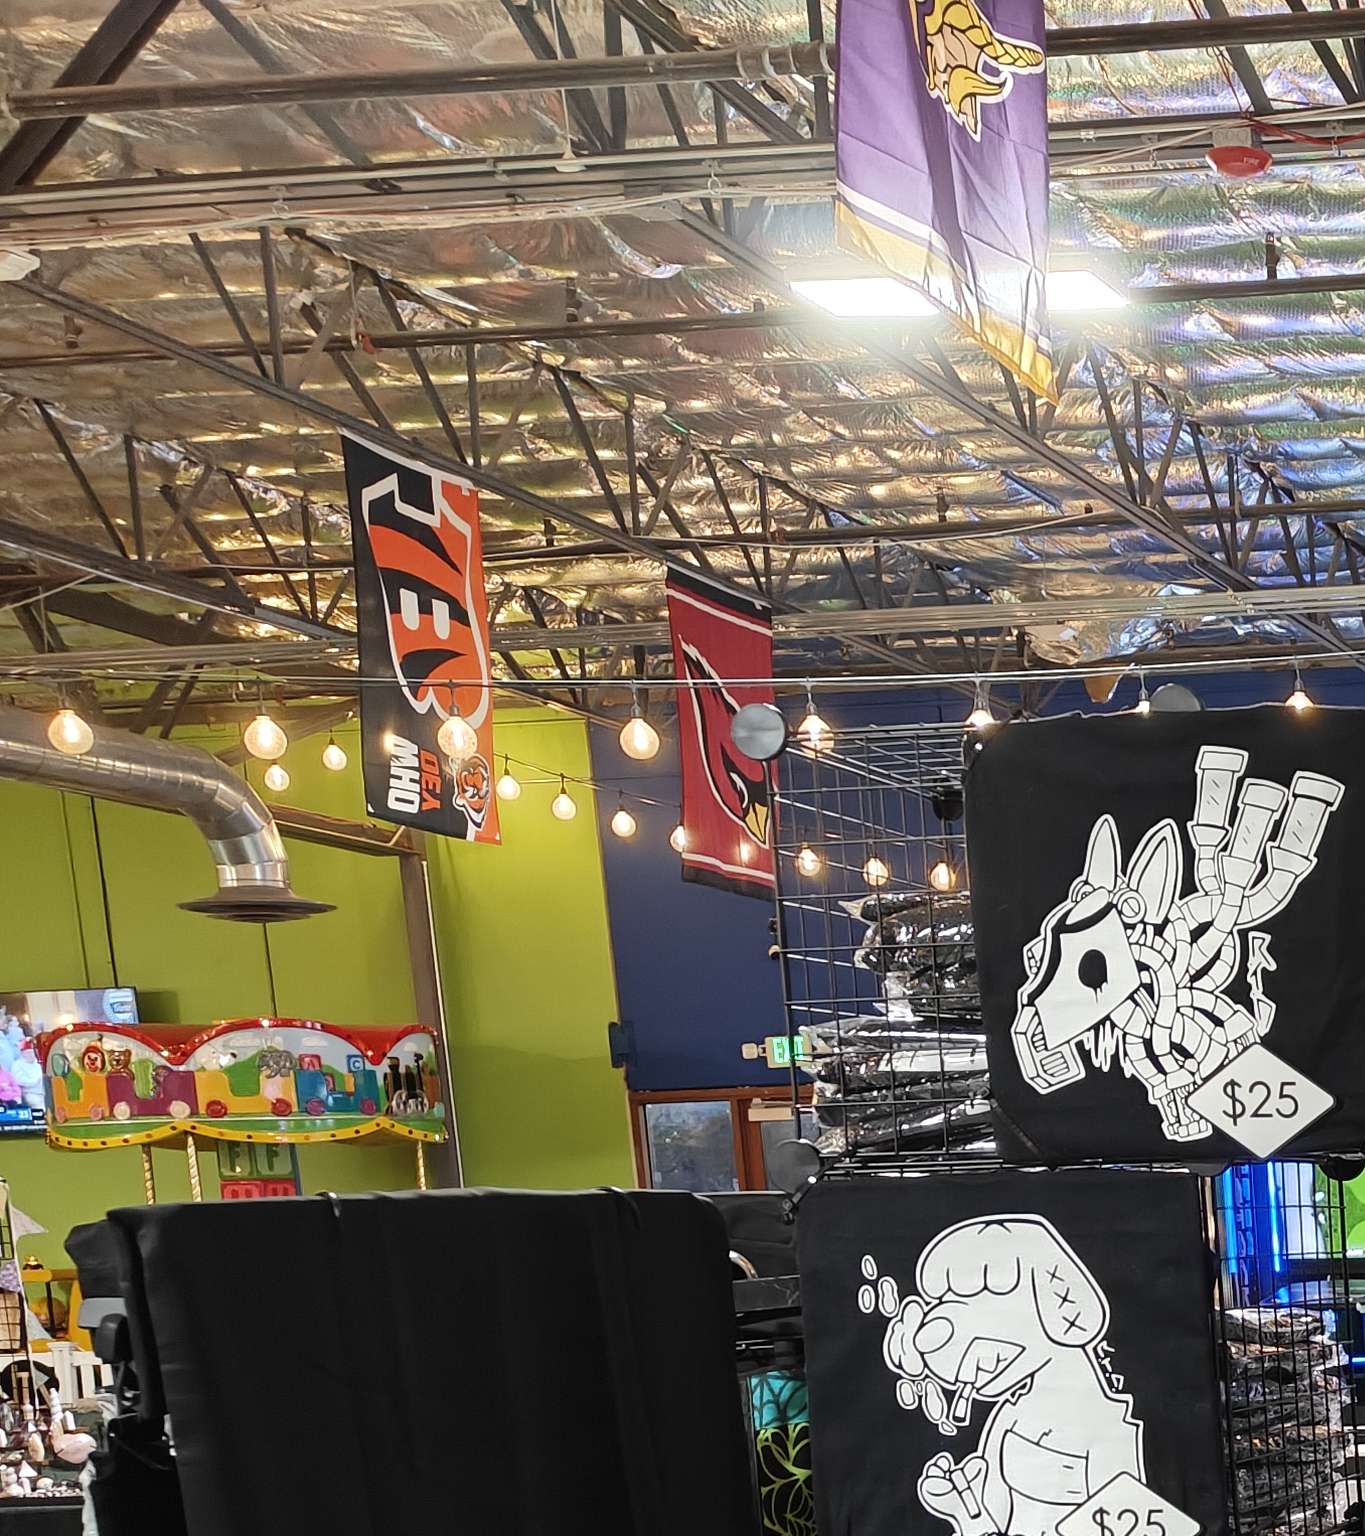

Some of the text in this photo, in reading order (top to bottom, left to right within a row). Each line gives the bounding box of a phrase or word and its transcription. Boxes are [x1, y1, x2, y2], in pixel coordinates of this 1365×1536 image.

[387, 734, 420, 814] WHO
[420, 749, 442, 811] DEY
[1221, 1077, 1300, 1125] $25
